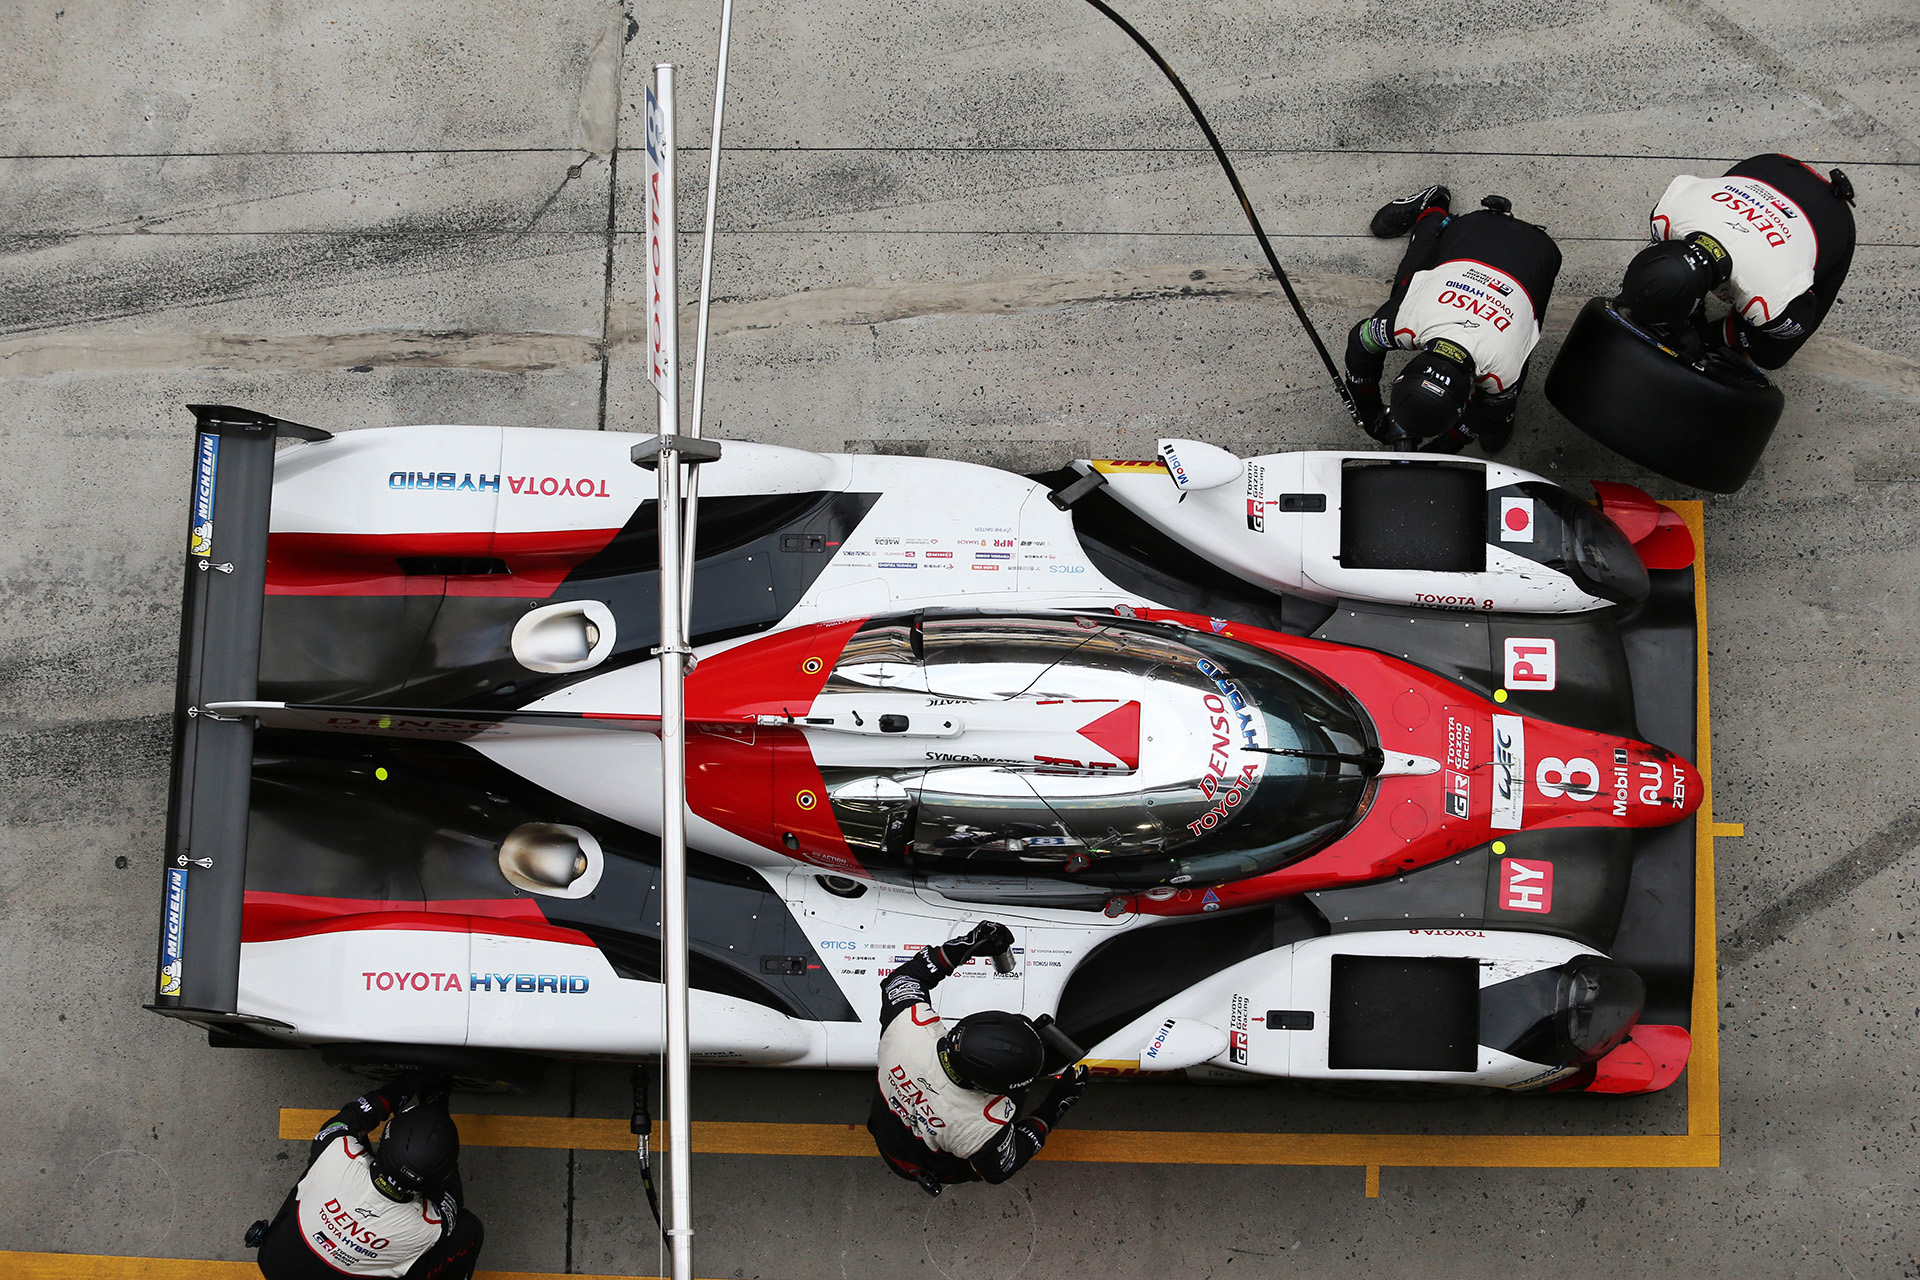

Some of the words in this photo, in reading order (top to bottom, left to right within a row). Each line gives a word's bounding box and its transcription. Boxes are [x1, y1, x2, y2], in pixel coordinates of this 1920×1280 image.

[1724, 184, 1765, 209] HYBRID
[1711, 192, 1786, 248] DENSO
[1764, 208, 1793, 240] TOYOTA
[650, 172, 662, 383] TOYOTA
[1446, 280, 1485, 298] HYBRID
[1437, 290, 1512, 333] DENSO
[1485, 294, 1515, 320] TOYOTA
[199, 436, 214, 519] MICHELIN
[389, 471, 500, 493] HYBRID
[507, 476, 610, 498] TOYOTA
[1167, 454, 1189, 485] Mobil
[1253, 501, 1264, 532] GR
[993, 539, 1014, 548] NPR
[1049, 565, 1085, 574] OTICS
[1415, 593, 1476, 605] TOYOTA
[1482, 599, 1494, 610] 8
[1513, 646, 1547, 682] P1
[1197, 657, 1259, 749] HYBRID
[1199, 694, 1231, 802] DENSO
[1447, 717, 1455, 765] TOYOTA
[1455, 722, 1463, 769] GAZOO
[1463, 725, 1471, 770] Racing
[1497, 728, 1512, 800] WEC
[1536, 757, 1600, 801] 8
[1187, 764, 1258, 837] TOYOTA
[1454, 775, 1468, 818] GR
[1612, 767, 1628, 816] Mobil
[1672, 764, 1684, 809] ZENT
[1508, 861, 1544, 910] HY
[167, 872, 182, 958] MICHELIN
[820, 940, 856, 950] OTICS
[362, 972, 463, 992] TOYOTA
[470, 973, 590, 994] HYBRID
[1230, 993, 1238, 1028] TOYOTA
[1242, 997, 1250, 1031] Racing
[1147, 1027, 1169, 1059] Mobil
[1236, 1032, 1247, 1065] GR
[887, 1073, 912, 1105] TOYOTA
[890, 1064, 946, 1128] DENSO
[318, 1207, 343, 1239] TOYOTA
[342, 1236, 378, 1259] HYBRID
[324, 1198, 390, 1250] DENSO
